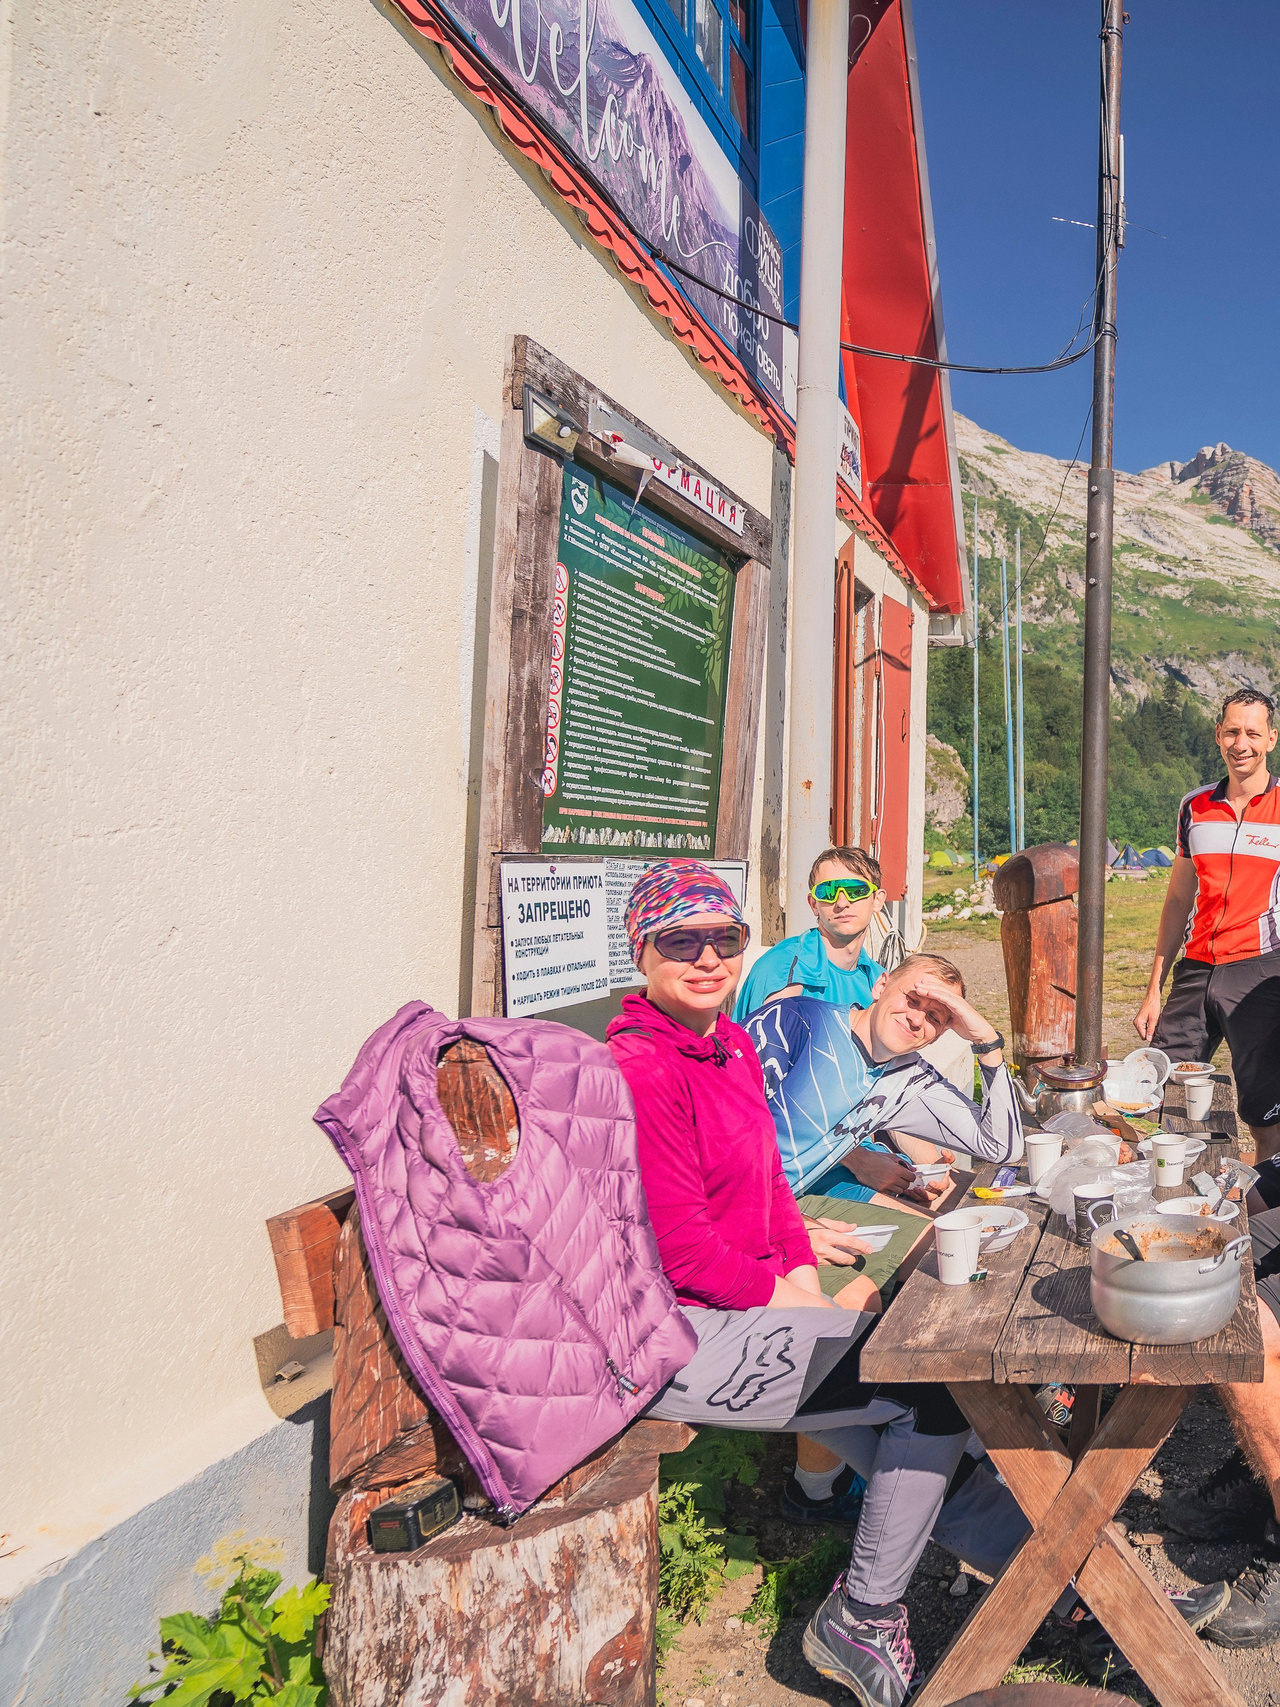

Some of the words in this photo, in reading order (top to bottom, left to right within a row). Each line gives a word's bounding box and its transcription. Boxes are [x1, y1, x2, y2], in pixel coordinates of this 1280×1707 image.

[507, 877, 519, 893] НА
[521, 876, 571, 892] ТЕРРИТОРИИ
[572, 875, 603, 890] ПРИЮТА
[518, 899, 590, 924] ЗАПРЕЩЕНО
[514, 936, 533, 948] ЗАПУСК
[533, 934, 552, 945] ЛЮБЫХ
[552, 930, 584, 943] ЛЕТАТЕЛЬНЫХ
[515, 969, 536, 982] ХОДИТЬ
[540, 965, 562, 977] ПЛАВКАХ
[516, 991, 543, 1006] НАРУШАТЬ
[543, 988, 560, 1000] РЕЖИМ
[560, 984, 580, 996] ТИШИНЫ
[580, 981, 595, 992] ПОСЛЕ
[595, 977, 608, 989] 22:00
